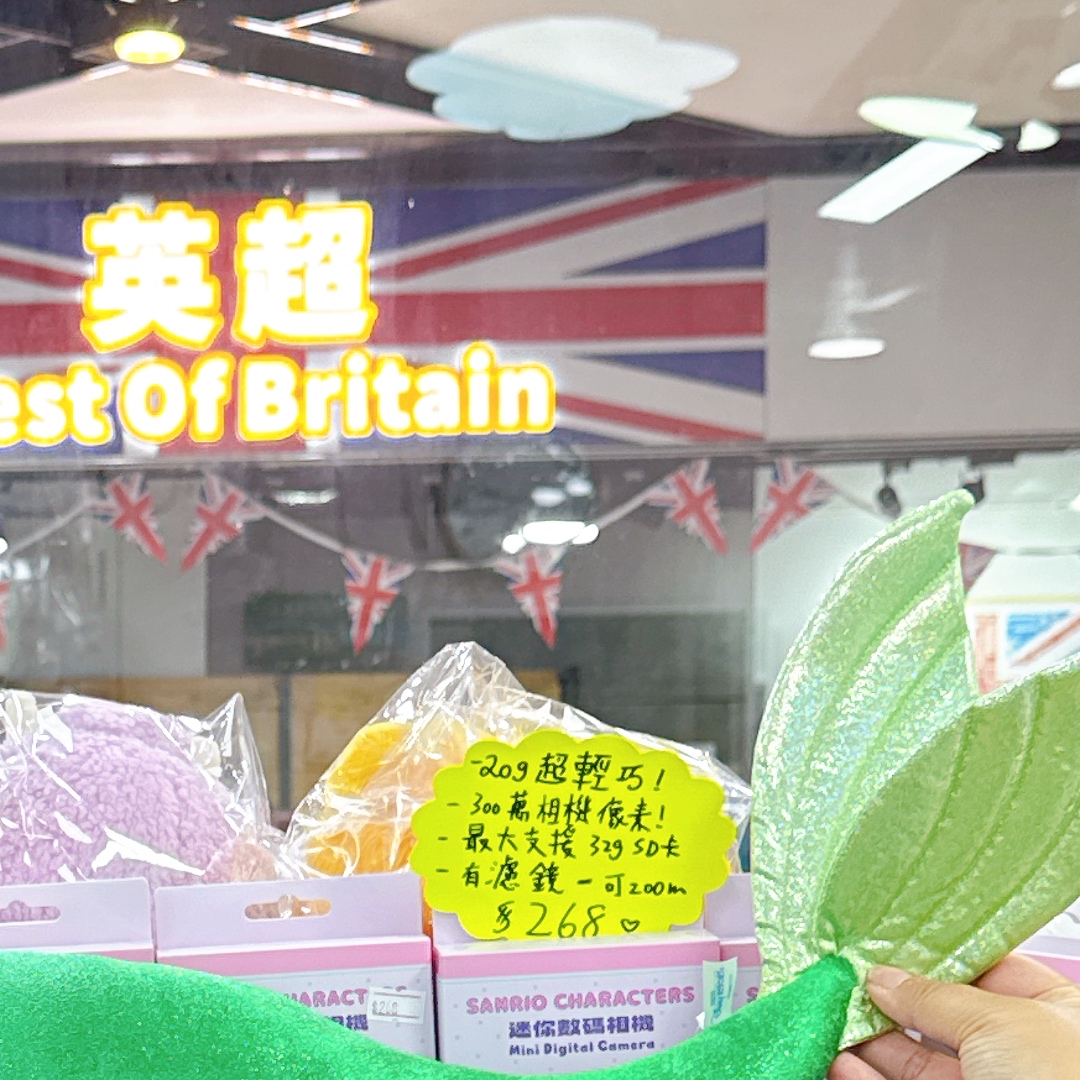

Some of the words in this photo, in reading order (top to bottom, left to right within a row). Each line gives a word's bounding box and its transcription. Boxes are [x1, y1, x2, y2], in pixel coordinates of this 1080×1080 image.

[82, 200, 377, 350] 英超
[119, 352, 234, 443] Of
[238, 342, 555, 440] Britain
[466, 994, 548, 1014] SANRIO
[553, 986, 695, 1010] CHARACTERS
[509, 1014, 655, 1039] 迷你數碼相機
[509, 1044, 540, 1056] Mini
[544, 1041, 594, 1056] Digital
[598, 1039, 655, 1052] Camera
